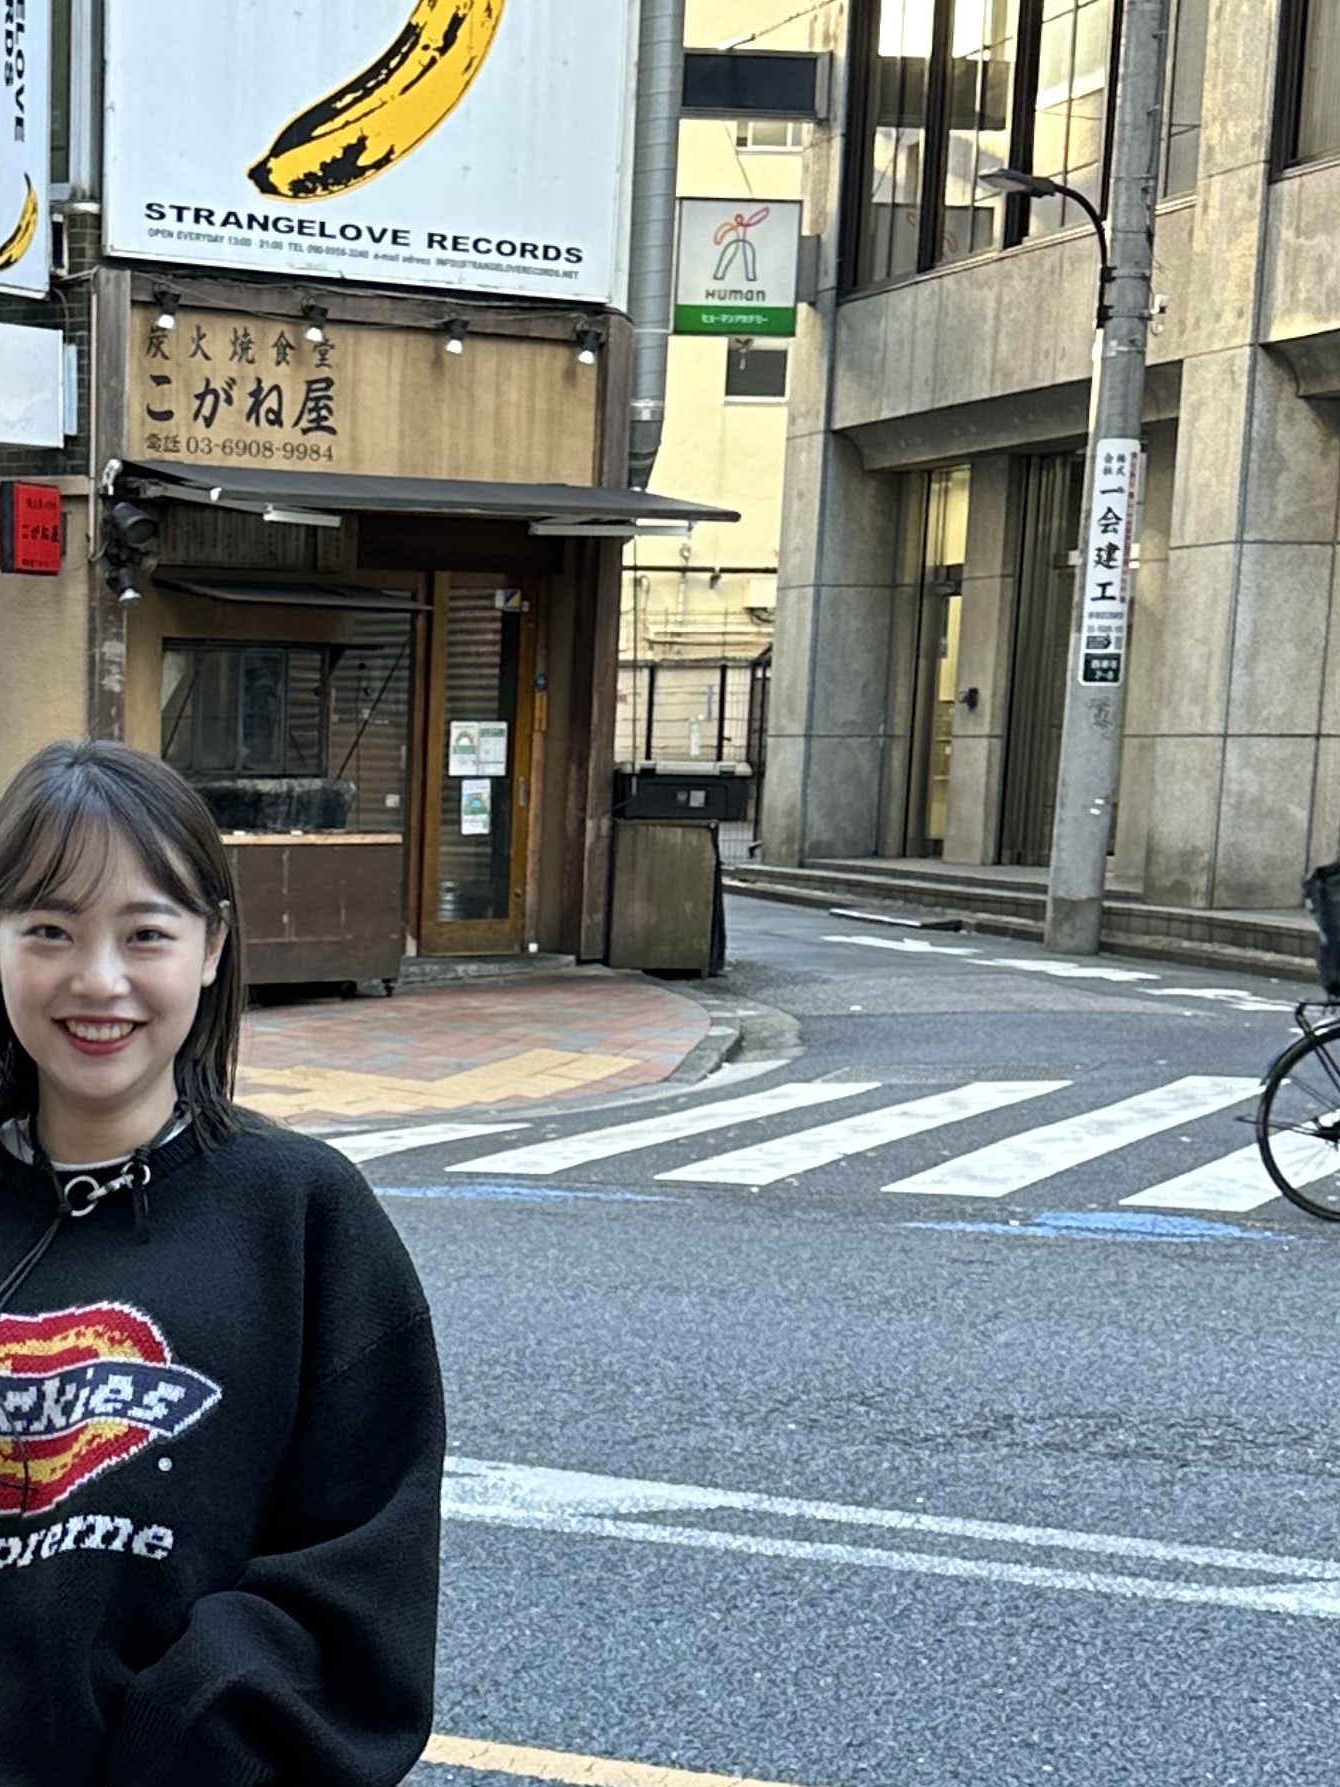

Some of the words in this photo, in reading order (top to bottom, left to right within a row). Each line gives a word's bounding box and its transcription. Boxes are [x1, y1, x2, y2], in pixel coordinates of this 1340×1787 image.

[144, 202, 411, 247] STRANGELOVE
[426, 231, 583, 264] RECORDS
[146, 374, 338, 435] こがね屋
[186, 436, 334, 462] 03-6908-9984
